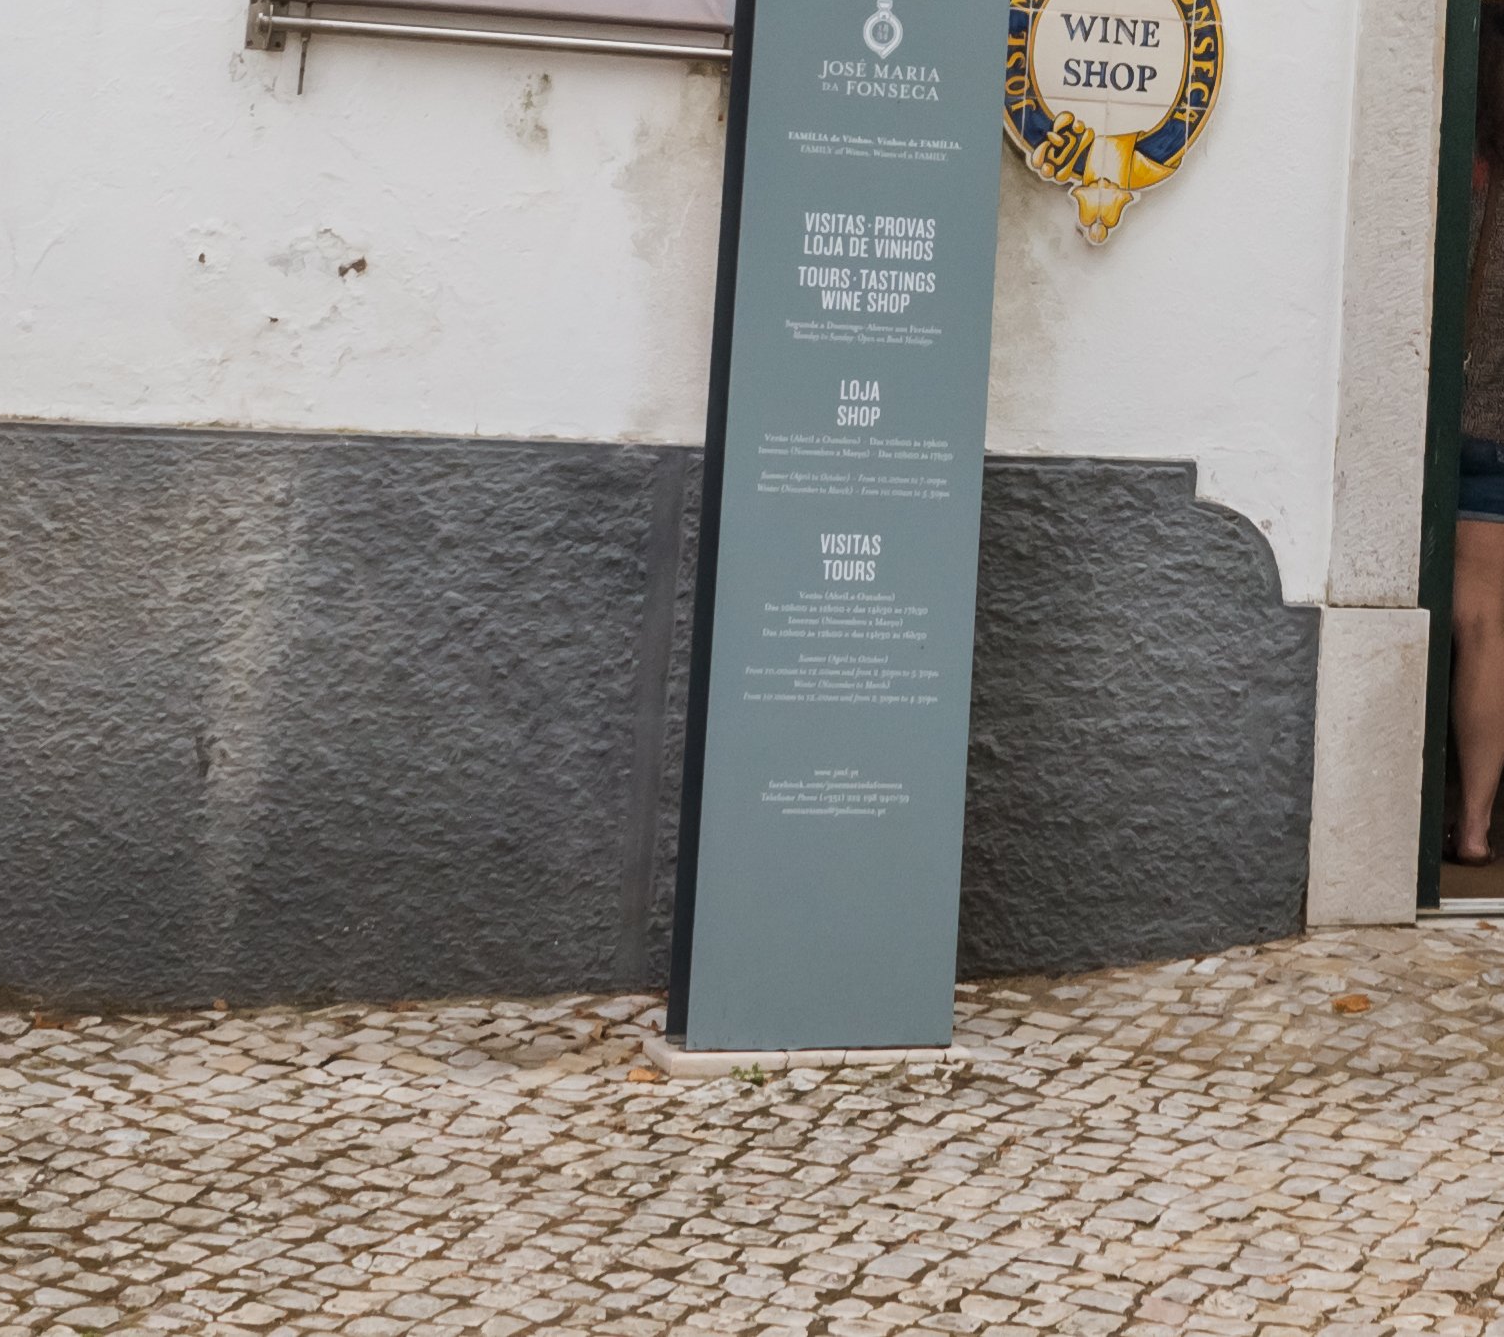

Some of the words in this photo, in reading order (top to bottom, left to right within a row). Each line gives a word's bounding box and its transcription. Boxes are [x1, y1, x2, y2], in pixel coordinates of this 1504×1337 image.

[1060, 13, 1161, 48] WINE
[817, 59, 867, 80] JOSÉ
[873, 63, 941, 83] MARIA
[1063, 58, 1158, 93] SHOP
[822, 82, 839, 92] DA
[846, 81, 939, 101] FONSECA
[804, 212, 865, 235] VISITAS
[875, 216, 936, 239] PROVAS
[804, 234, 843, 257] LOJA
[849, 237, 869, 258] DE
[874, 238, 934, 261] VINHOS
[798, 266, 851, 288] TOURS
[860, 269, 936, 293] TASTINGS
[821, 290, 861, 312] WINE
[867, 292, 911, 314] SHOP
[840, 379, 881, 402] LOJA
[836, 405, 881, 427] SHOP
[820, 533, 882, 557] VISITAS
[822, 559, 877, 582] TOURS
